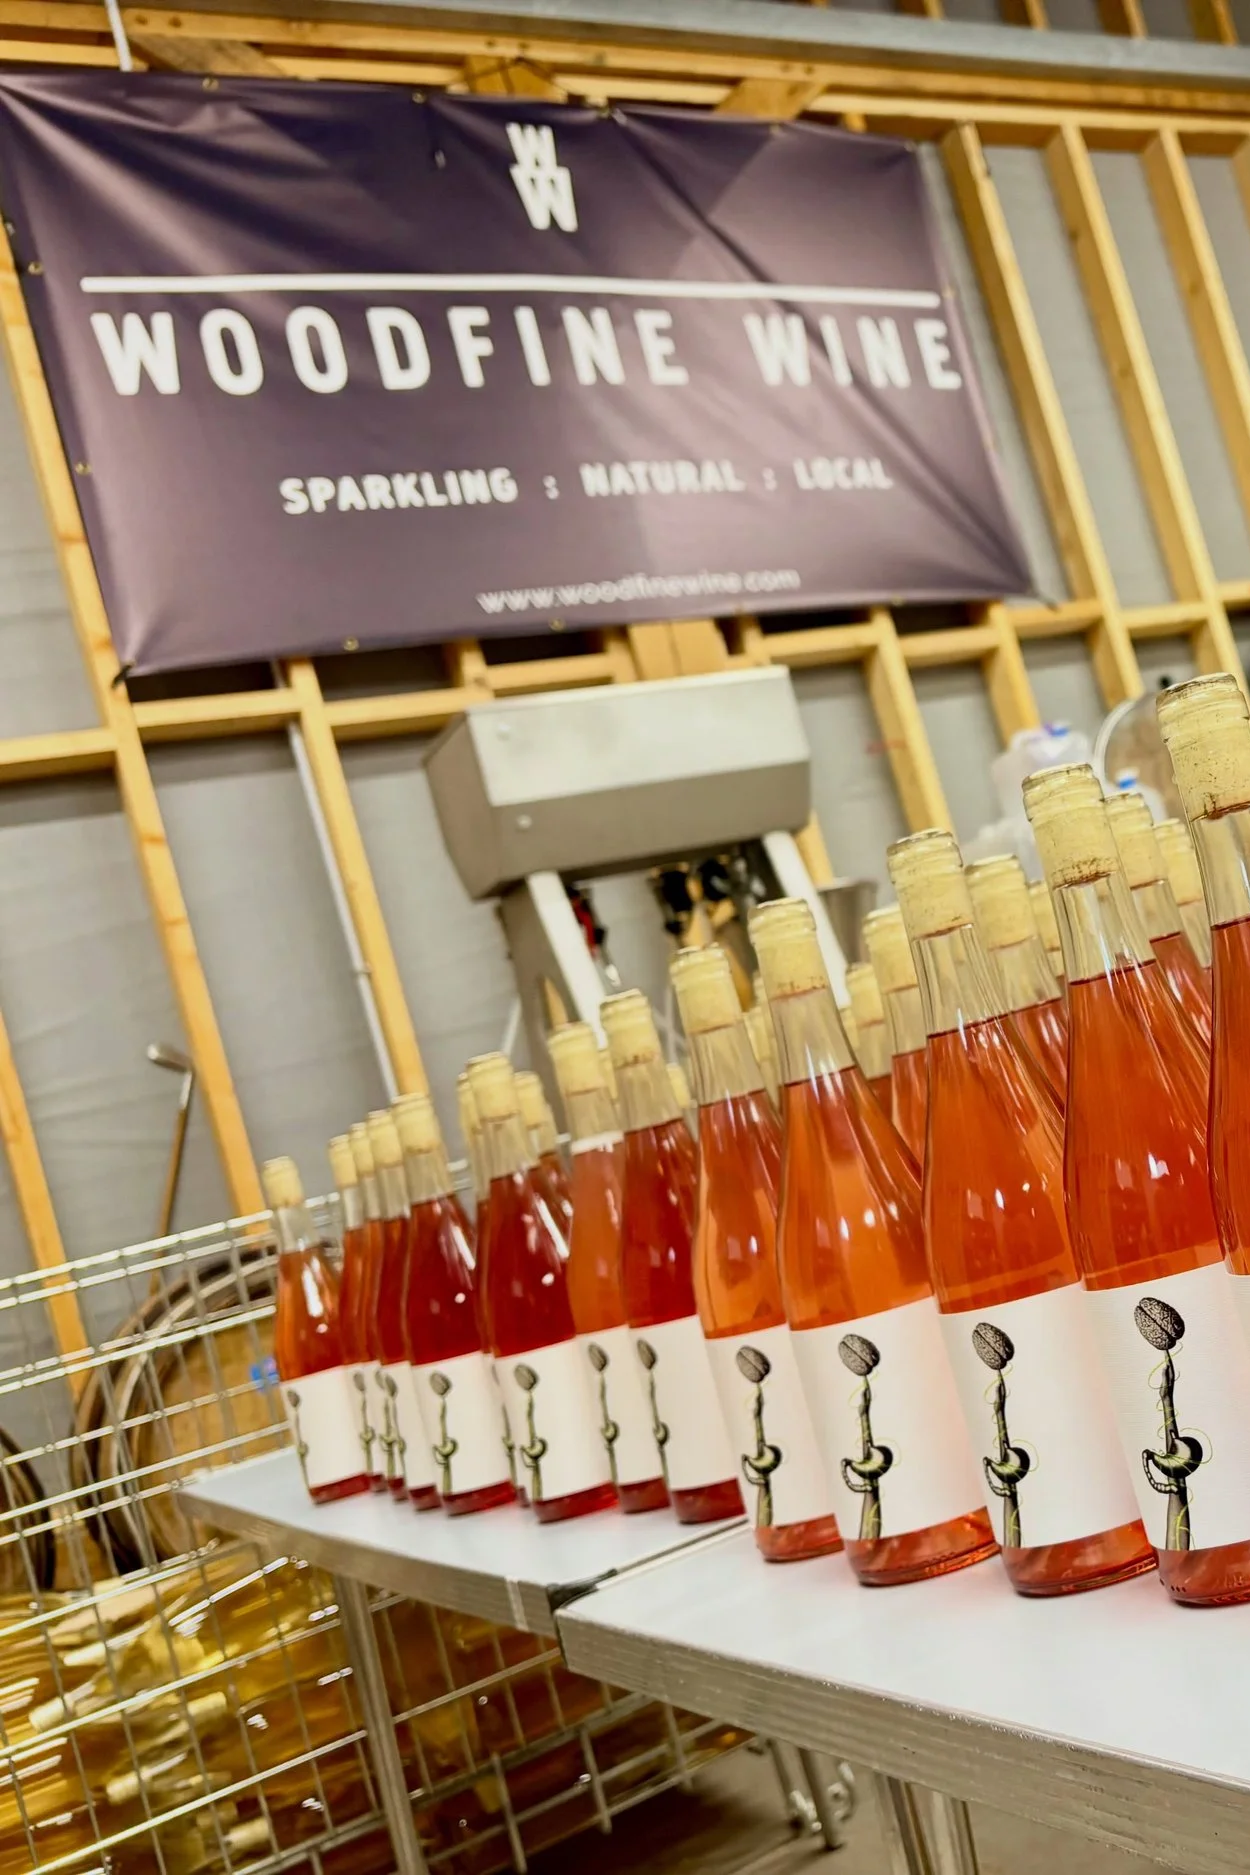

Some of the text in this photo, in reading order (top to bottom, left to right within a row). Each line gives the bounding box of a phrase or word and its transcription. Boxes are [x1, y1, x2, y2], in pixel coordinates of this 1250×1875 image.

[91, 307, 961, 396] WOODFINE WINE
[280, 467, 518, 515] SPARKLING
[579, 460, 745, 497] NATURAL
[793, 456, 893, 491] LOCAL
[477, 570, 800, 613] www.woodfinewine.com
